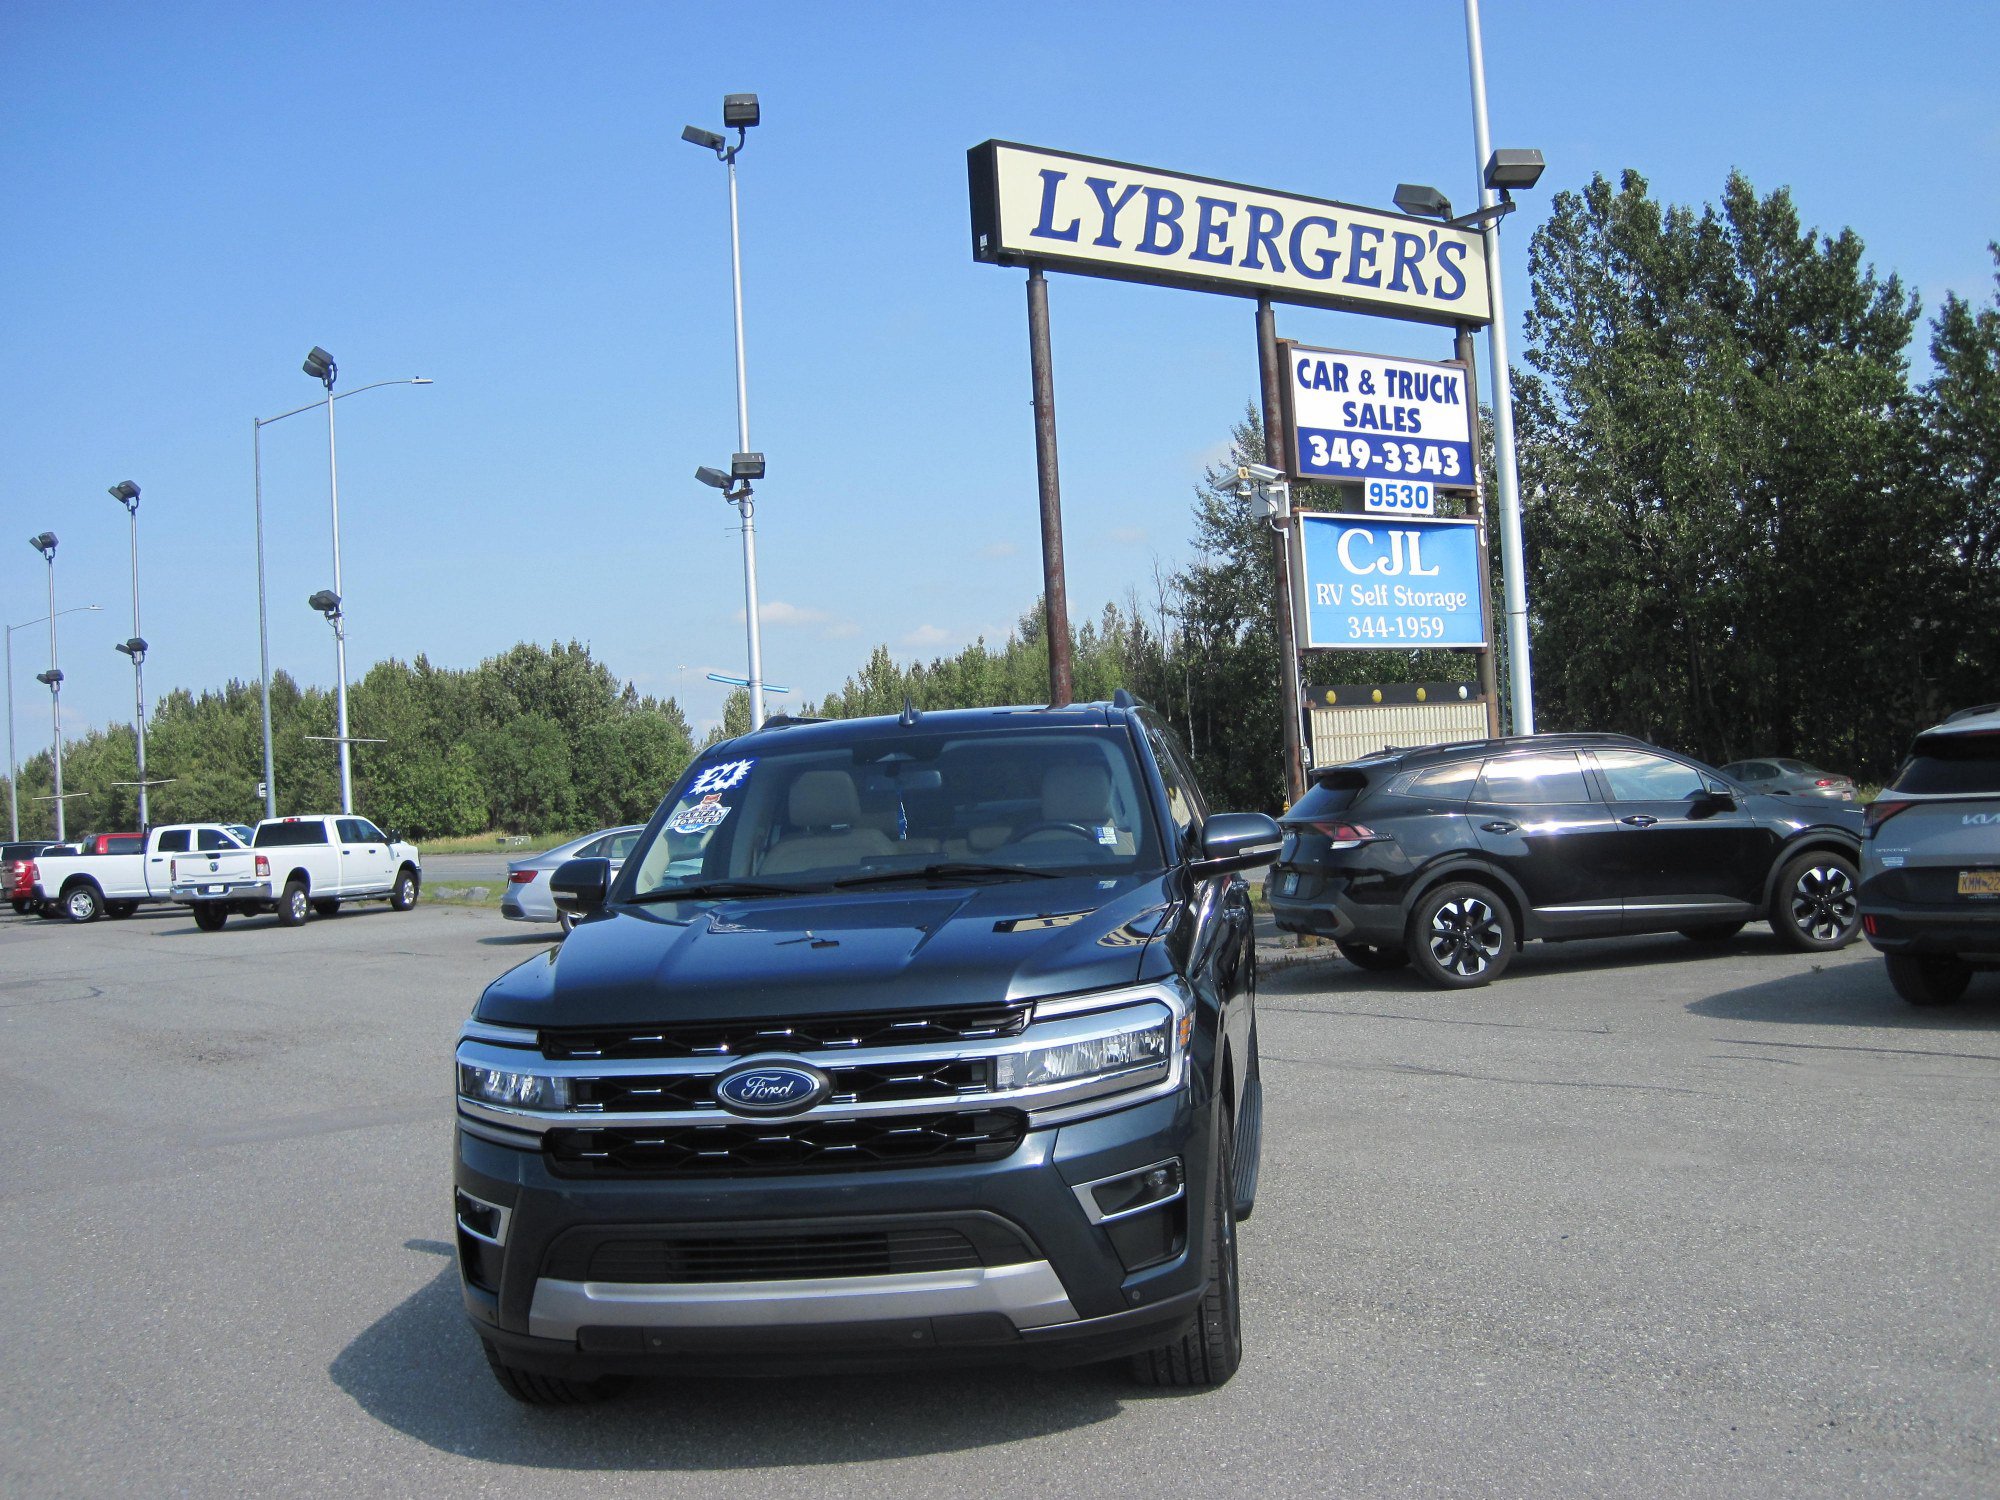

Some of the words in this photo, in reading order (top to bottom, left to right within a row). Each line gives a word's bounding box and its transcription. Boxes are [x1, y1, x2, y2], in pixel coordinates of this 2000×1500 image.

[1030, 168, 1467, 301] LYBERGER'S
[1296, 358, 1349, 393] CAR
[1358, 369, 1376, 396] &
[1384, 368, 1460, 405] TRUCK
[1342, 401, 1422, 434] SALES
[1308, 434, 1461, 477] 349-3343
[1369, 482, 1429, 509] 9530
[1336, 528, 1440, 577] CJL
[1315, 582, 1344, 607] RV
[1350, 582, 1389, 607] Self
[1393, 583, 1468, 612] Storage
[1347, 615, 1446, 640] 344-1959
[741, 1075, 794, 1100] Ford
